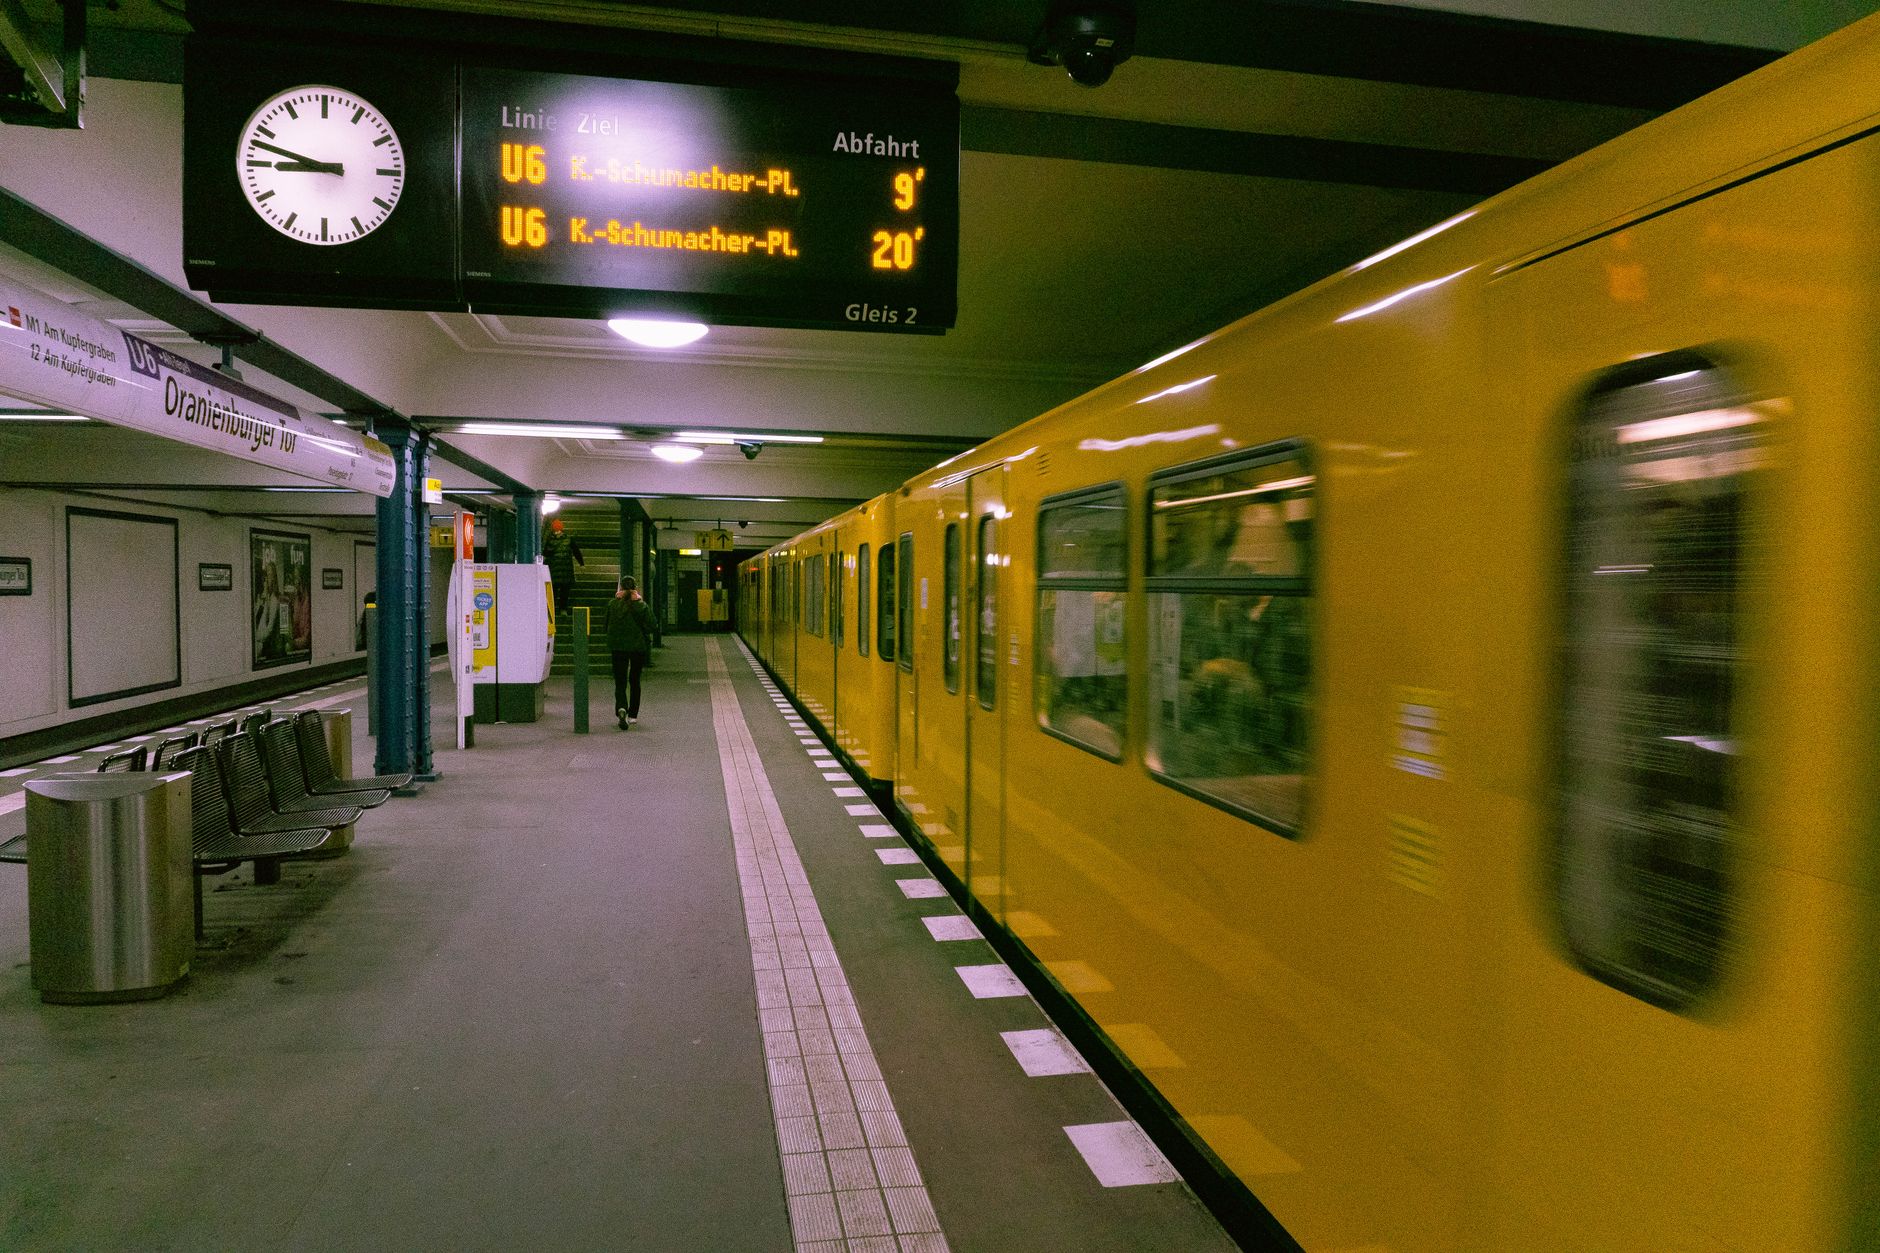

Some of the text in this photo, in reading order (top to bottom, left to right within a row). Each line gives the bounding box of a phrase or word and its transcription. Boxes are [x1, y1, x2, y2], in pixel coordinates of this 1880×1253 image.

[501, 106, 620, 136] Linie Ziel
[833, 131, 920, 159] Abfahrt
[501, 143, 547, 185] U6
[569, 156, 799, 197] K.-Schumacher-Pl.
[501, 206, 547, 248] U6
[569, 217, 799, 257] K.-Schumacher-Pl.
[845, 303, 918, 325] Gleis 2
[26, 314, 116, 363] M1 Am Kupfergraben
[127, 335, 158, 375] U6
[30, 343, 116, 386] 12 Am Kupfergraben
[164, 375, 299, 454] Oranienburger Tor
